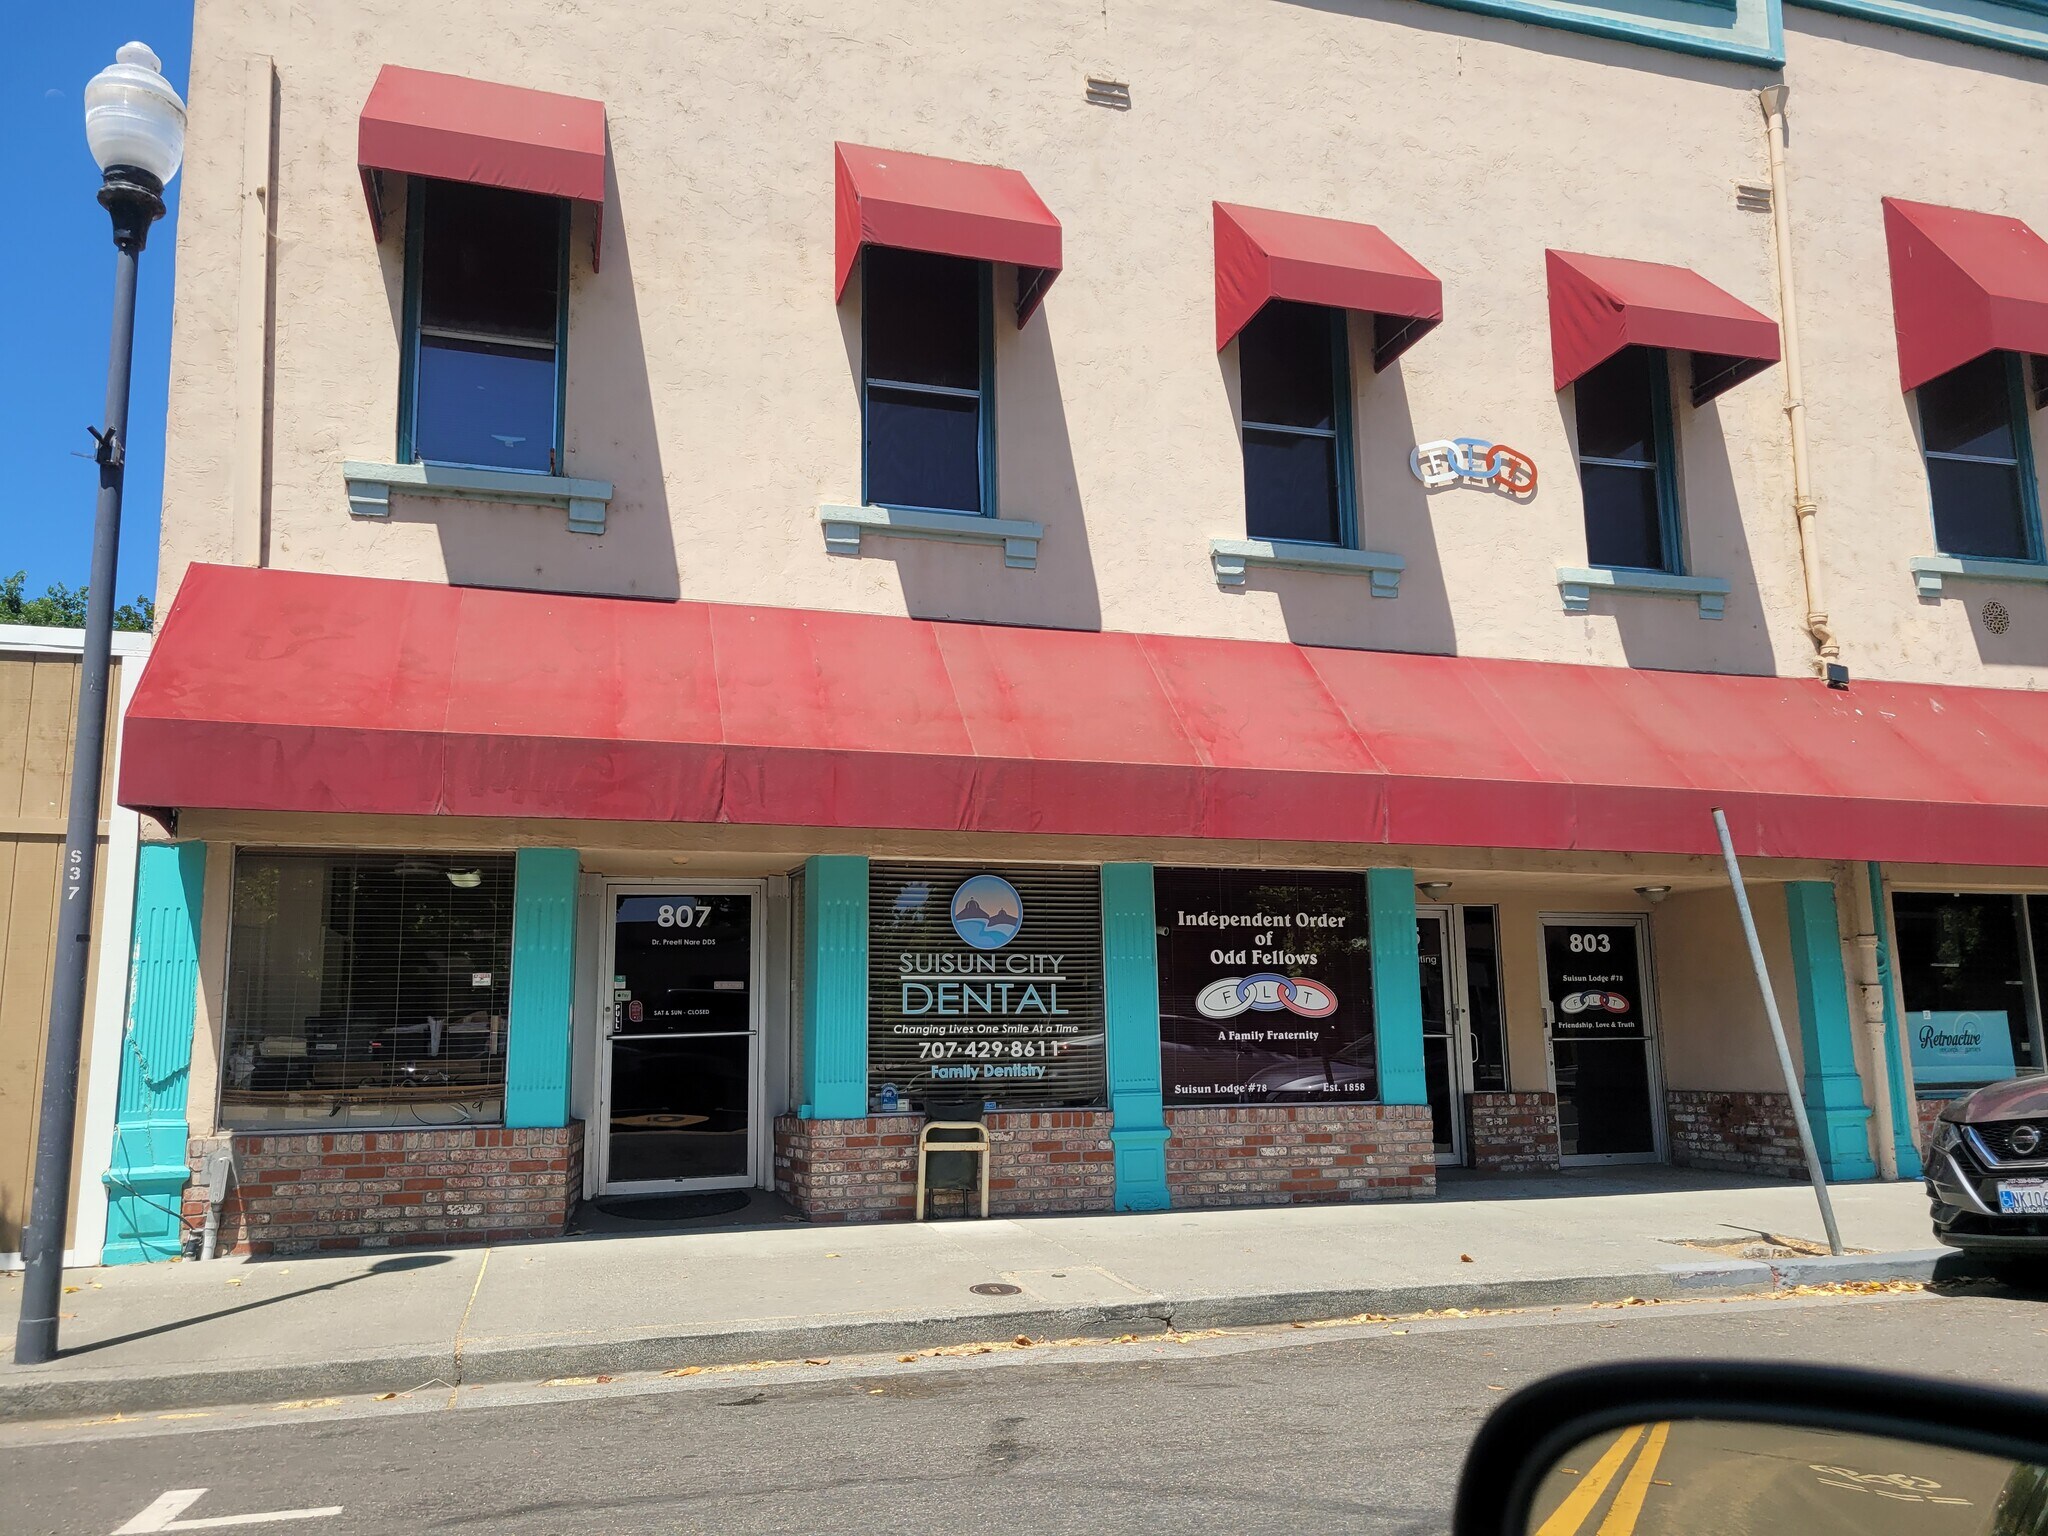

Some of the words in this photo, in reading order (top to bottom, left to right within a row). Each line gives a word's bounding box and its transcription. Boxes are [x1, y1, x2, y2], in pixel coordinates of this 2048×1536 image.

[68, 849, 82, 900] S37
[657, 904, 712, 928] 807
[1178, 911, 1291, 929] Independent
[1296, 912, 1346, 928] Order
[1254, 931, 1273, 946] of
[1569, 933, 1611, 953] 803
[898, 952, 996, 973] SUISUN
[1005, 953, 1065, 974] CITY
[1210, 949, 1247, 965] Odd
[1251, 950, 1318, 966] Fellows
[1419, 955, 1437, 965] ting
[1588, 975, 1609, 983] Lodge
[902, 982, 1069, 1015] DENTAL
[1222, 991, 1231, 1004] F
[1263, 986, 1271, 998] L
[1303, 991, 1313, 1004] T
[893, 1024, 946, 1036] Changing
[949, 1024, 974, 1034] Lives
[977, 1024, 999, 1034] One
[1001, 1024, 1029, 1034] Smile
[1032, 1024, 1044, 1034] At
[1045, 1026, 1053, 1034] a
[1055, 1024, 1079, 1034] Time
[1218, 1031, 1227, 1041] A
[1228, 1030, 1264, 1042] Family
[1266, 1030, 1319, 1042] Fraternity
[1919, 1025, 1982, 1049] Retroactive
[931, 1064, 980, 1081] Family
[983, 1063, 1047, 1080] Dentistry
[1174, 1084, 1212, 1094] Suisun
[1214, 1084, 1246, 1096] Lodge
[1247, 1083, 1268, 1093] #78
[1323, 1083, 1341, 1092] Est.
[1343, 1083, 1366, 1092] 1858
